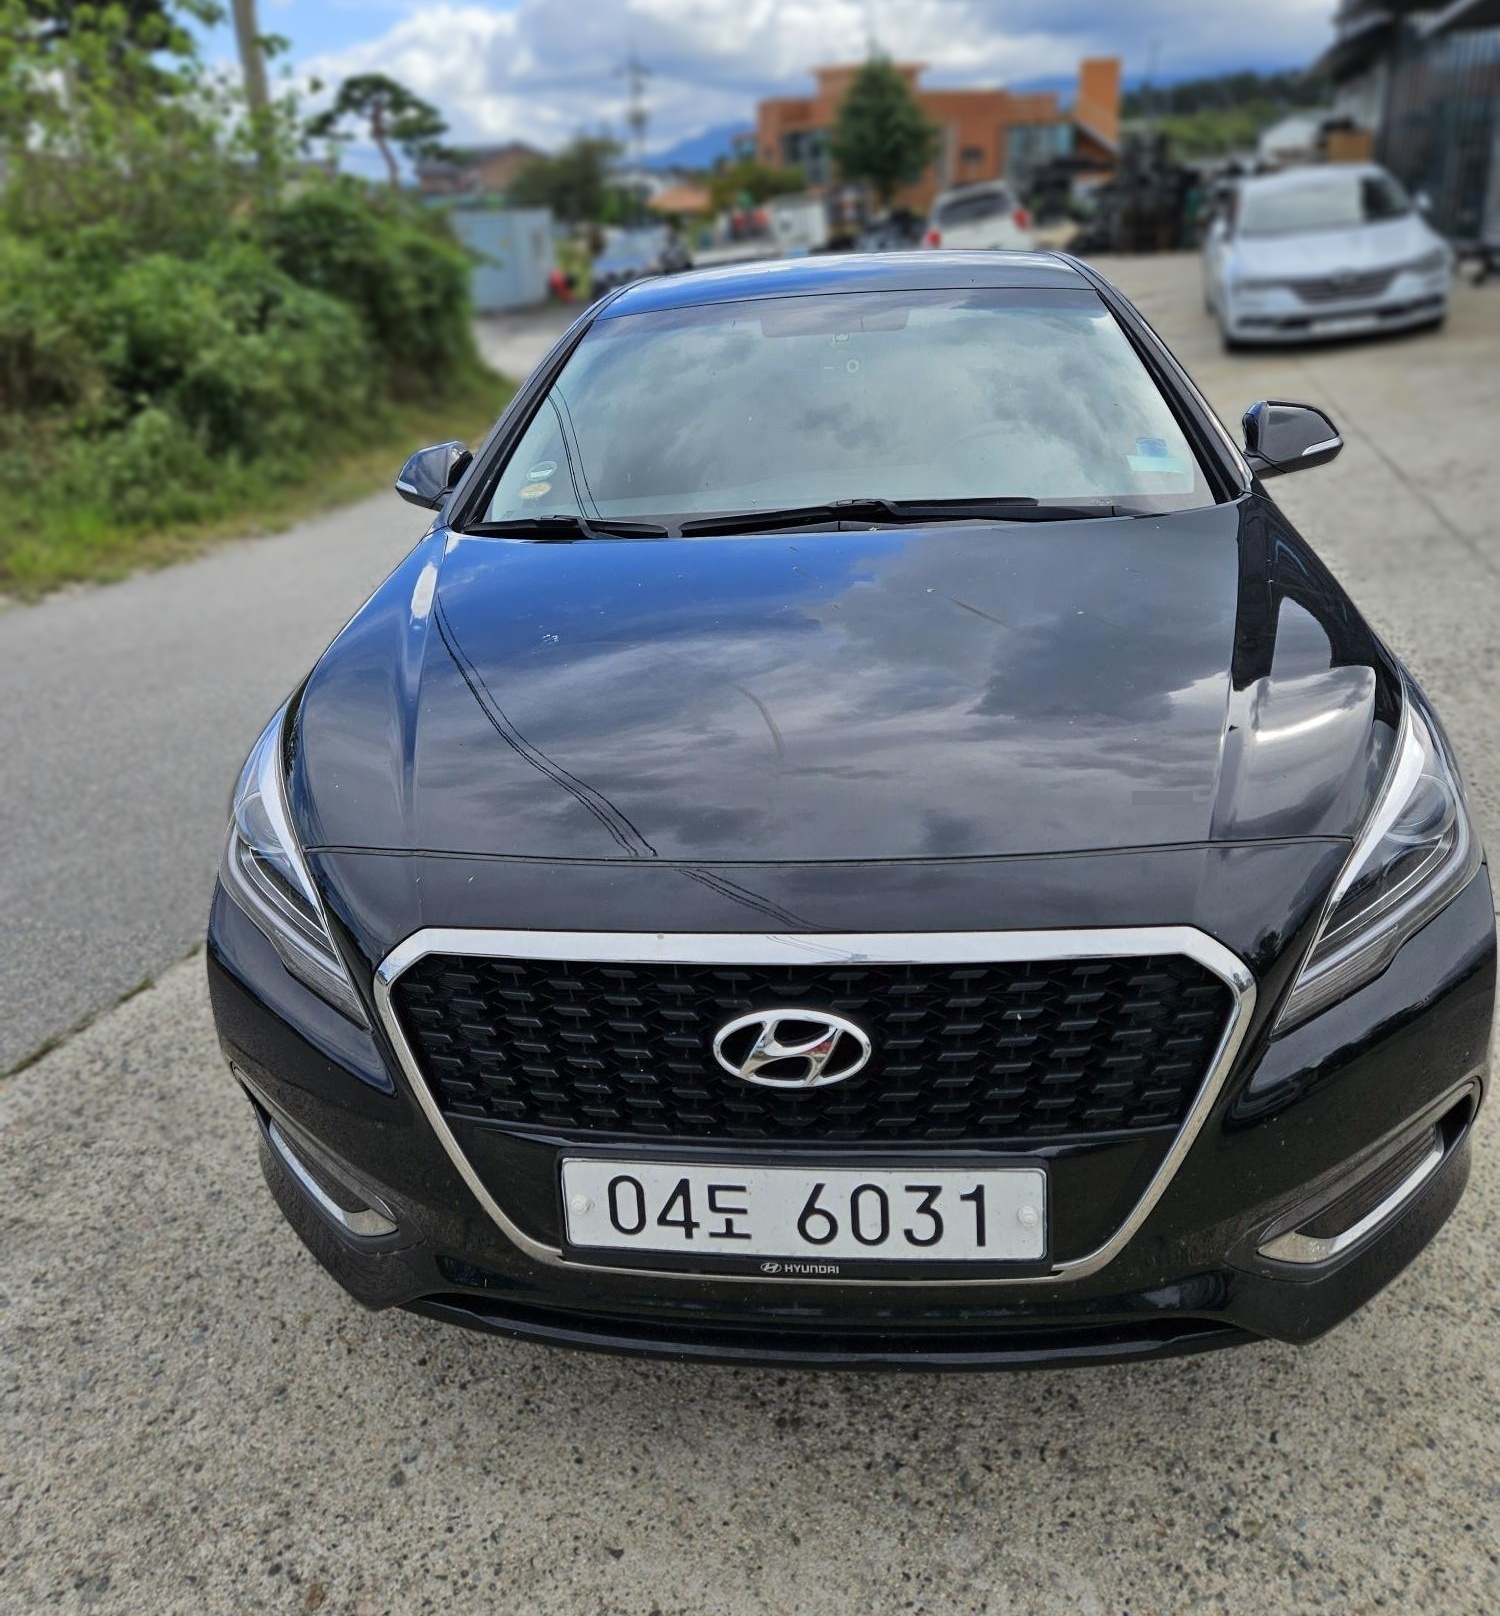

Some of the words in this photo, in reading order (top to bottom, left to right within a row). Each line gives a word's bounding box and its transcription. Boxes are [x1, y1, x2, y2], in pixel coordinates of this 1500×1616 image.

[608, 1174, 753, 1240] 04도
[797, 1183, 986, 1248] 6031
[784, 1263, 840, 1274] HYUNDAI
